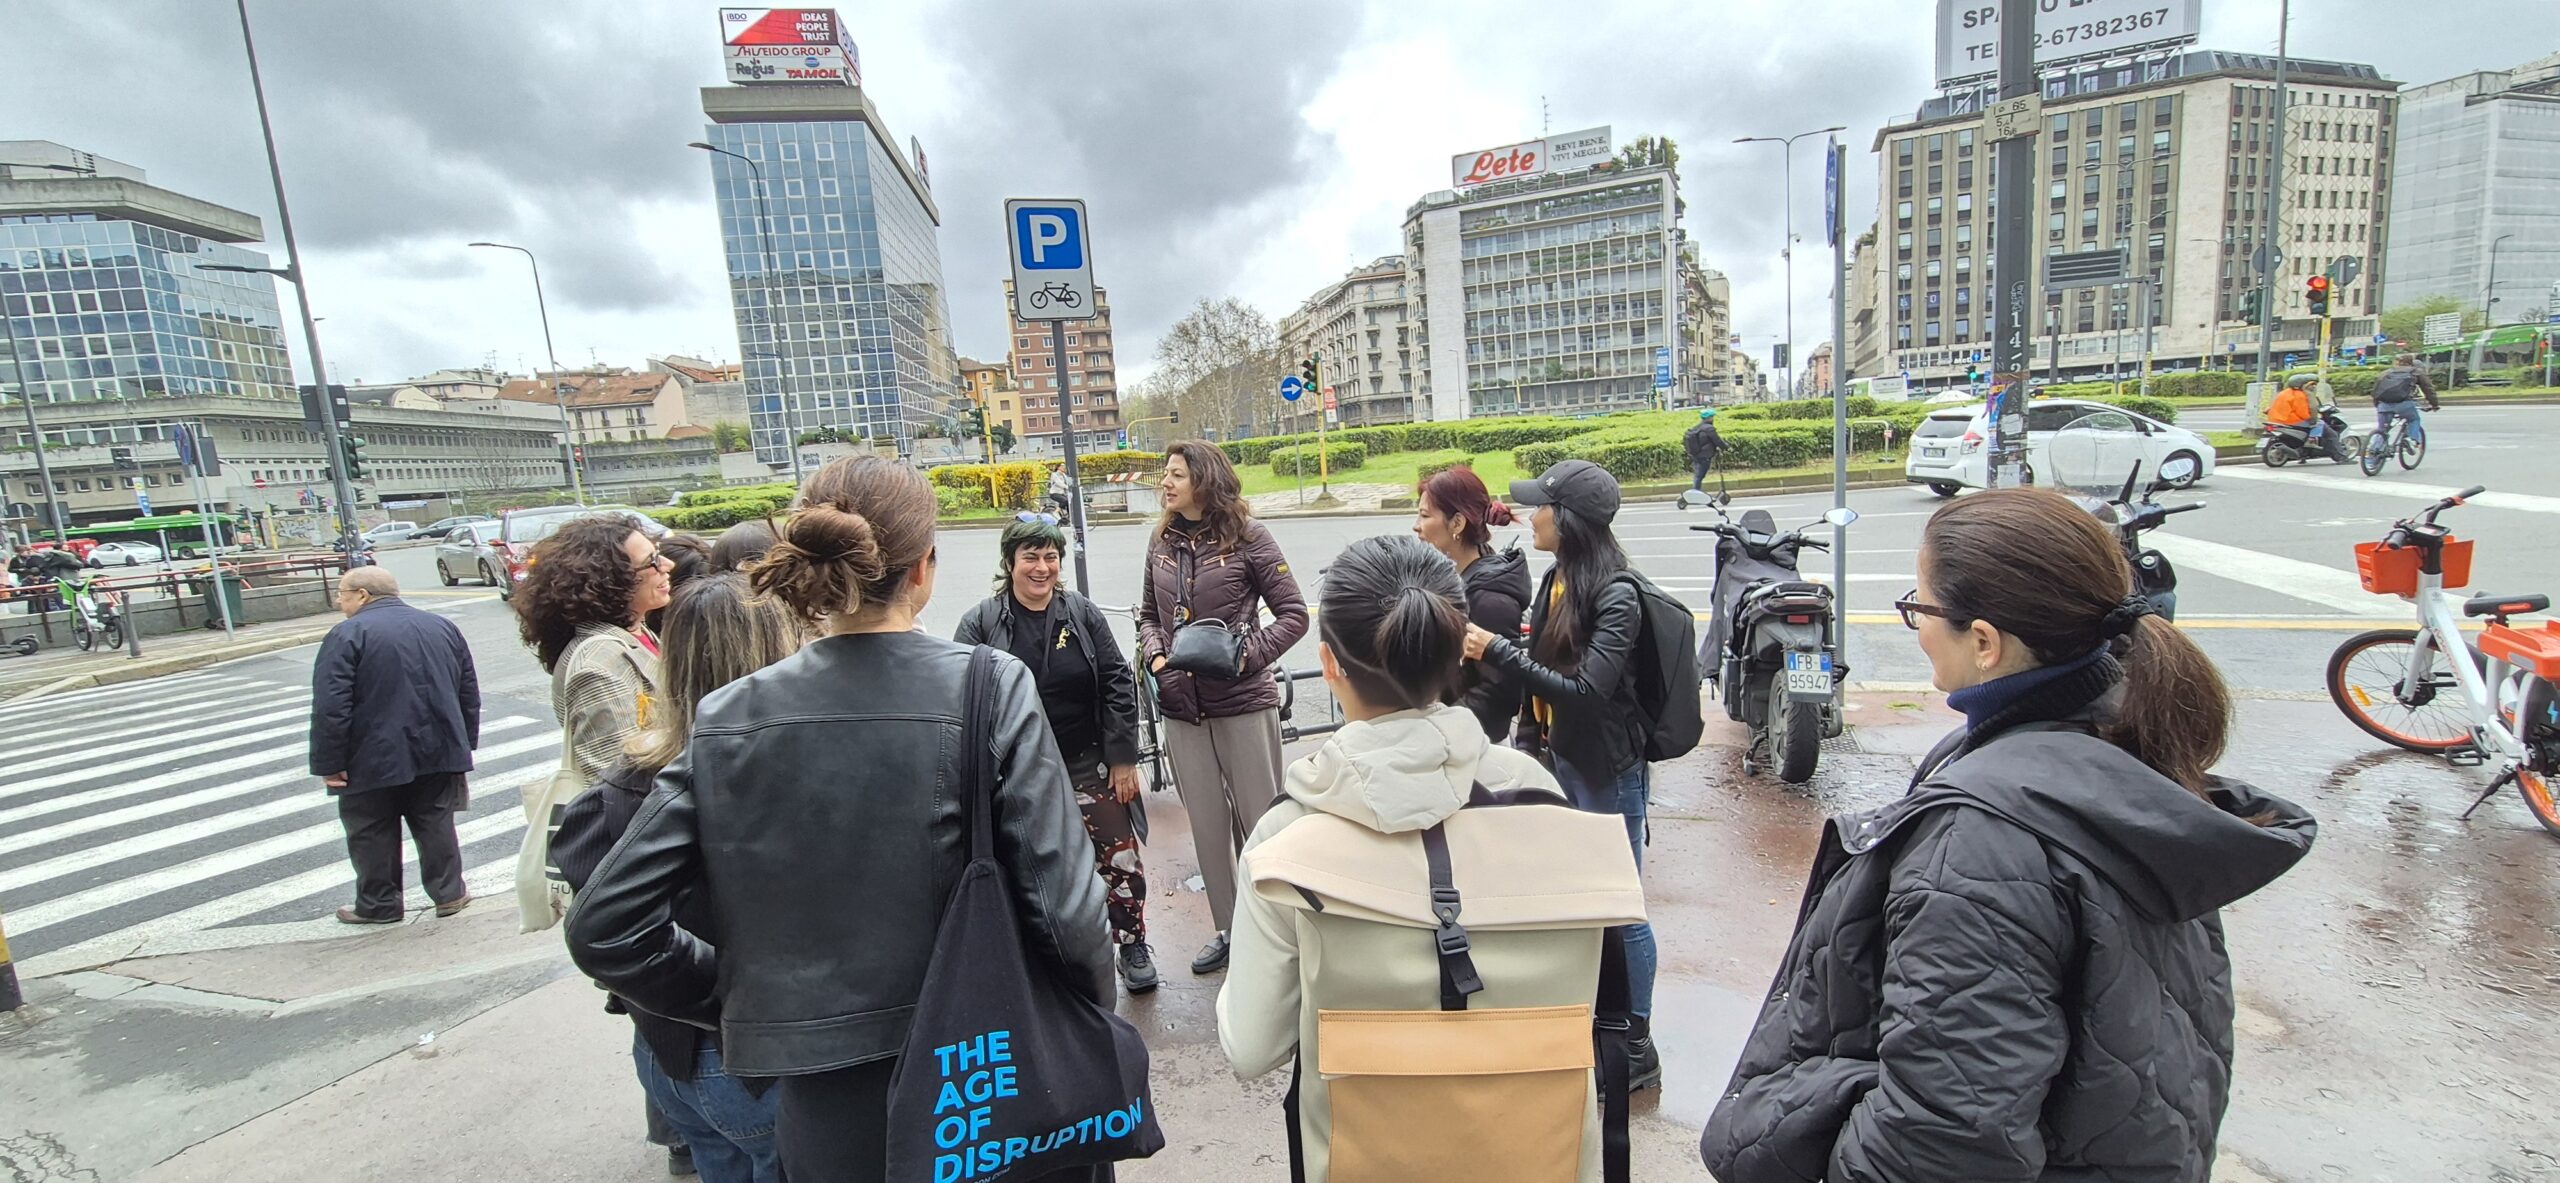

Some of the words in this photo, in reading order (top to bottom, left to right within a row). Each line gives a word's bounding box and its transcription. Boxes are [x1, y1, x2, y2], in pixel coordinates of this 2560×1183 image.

[727, 13, 747, 21] BDO
[801, 13, 828, 21] IDEAS
[796, 22, 829, 32] PEOPLE
[2033, 8, 2169, 49] 2-67382367
[801, 32, 830, 41] TRUST
[733, 46, 789, 57] SHISEIDO
[792, 47, 831, 56] GROUP
[735, 62, 775, 79] Regus
[786, 68, 841, 79] TAMOIL
[2012, 100, 2026, 111] 65
[1555, 141, 1577, 152] BEVI
[1551, 152, 1571, 161] VIVI
[1463, 148, 1536, 184] Lete
[1029, 214, 1067, 263] P
[1797, 655, 1813, 670] FB
[1790, 674, 1829, 690] 95947
[934, 1030, 1012, 1077] THE
[933, 1065, 1019, 1115] AGE
[934, 1106, 991, 1149] OF
[933, 1096, 1143, 1183] DISRUPTION
